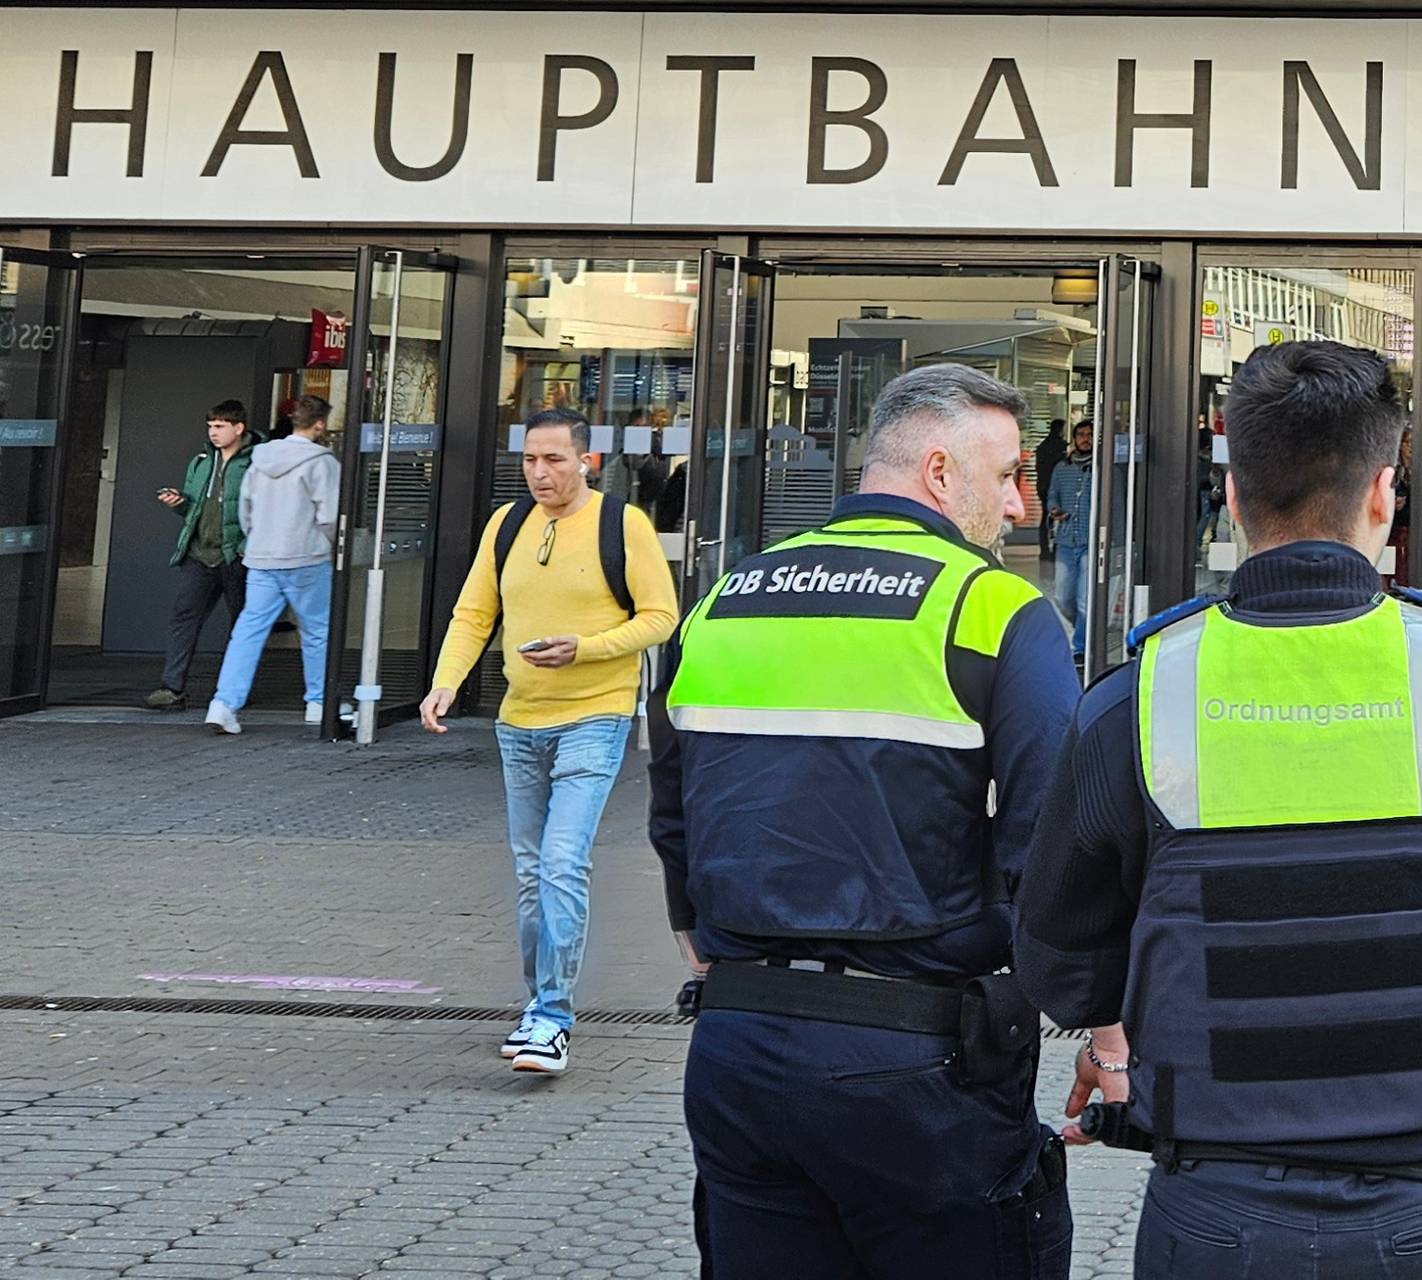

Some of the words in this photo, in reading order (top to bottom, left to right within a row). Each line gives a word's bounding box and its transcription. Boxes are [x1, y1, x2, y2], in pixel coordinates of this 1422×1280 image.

[719, 568, 764, 597] DB
[765, 563, 925, 597] Sicherheit
[1204, 696, 1405, 726] Ordnungsamt
